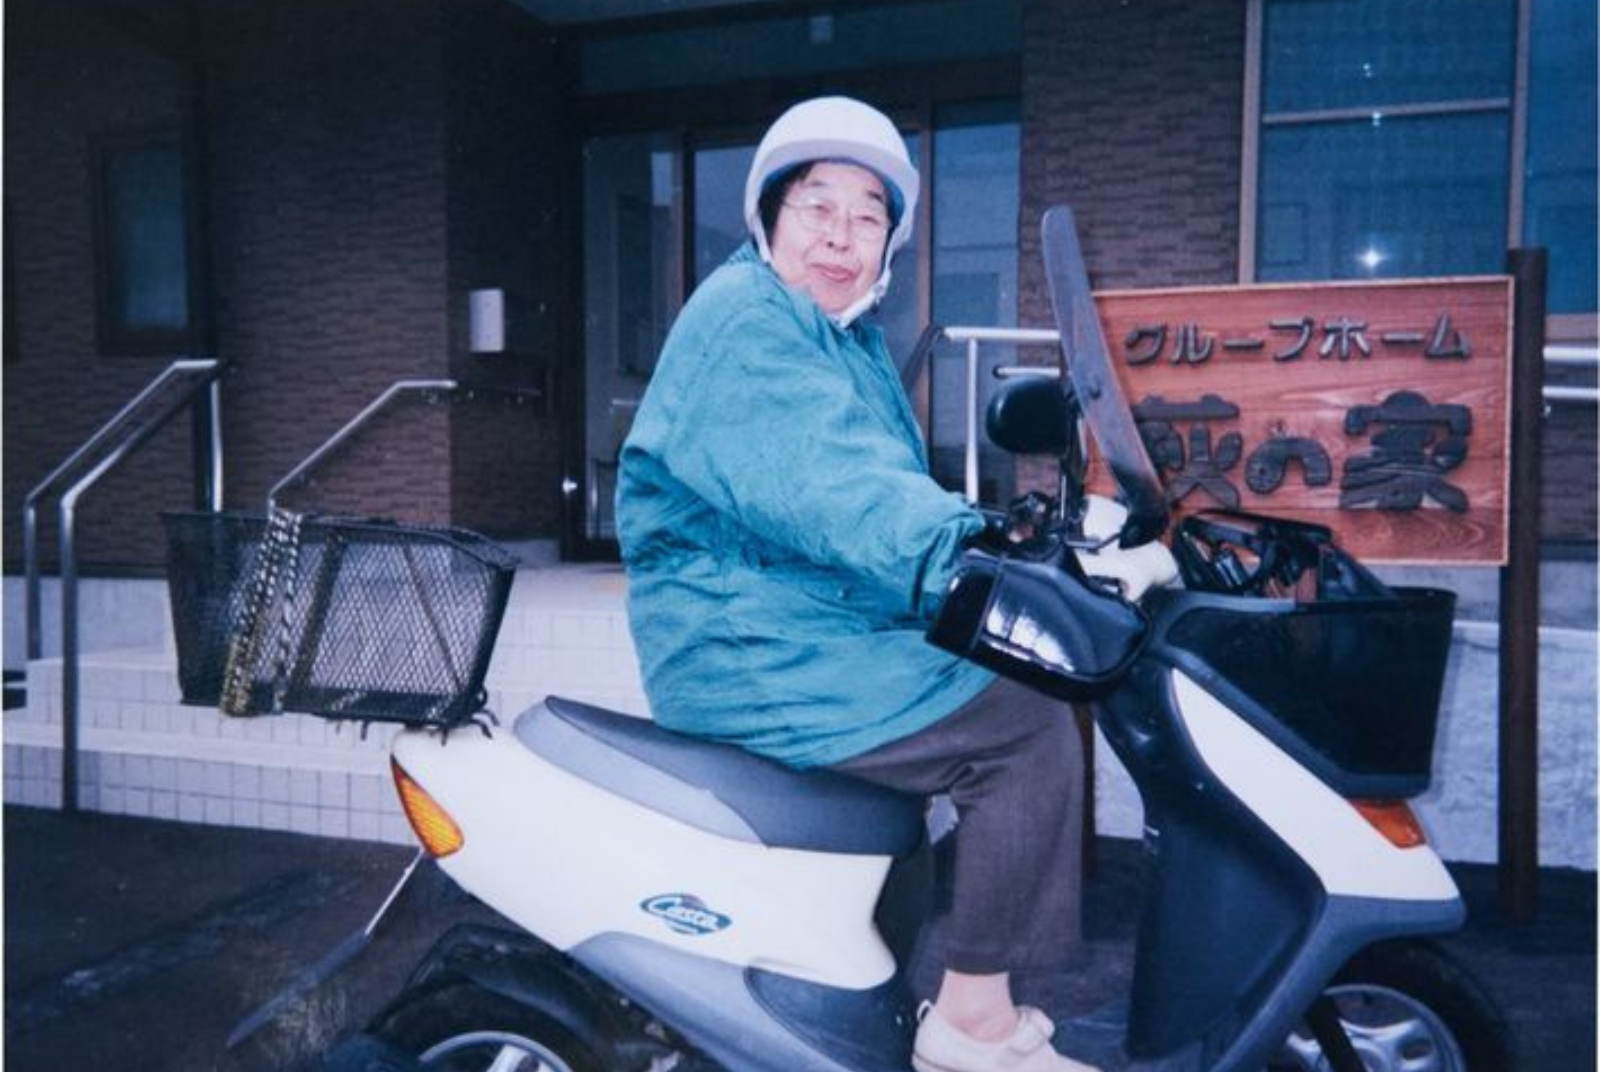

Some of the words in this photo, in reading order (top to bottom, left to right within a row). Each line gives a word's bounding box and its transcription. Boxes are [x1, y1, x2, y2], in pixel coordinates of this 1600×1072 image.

[1126, 315, 1472, 365] グループホーム
